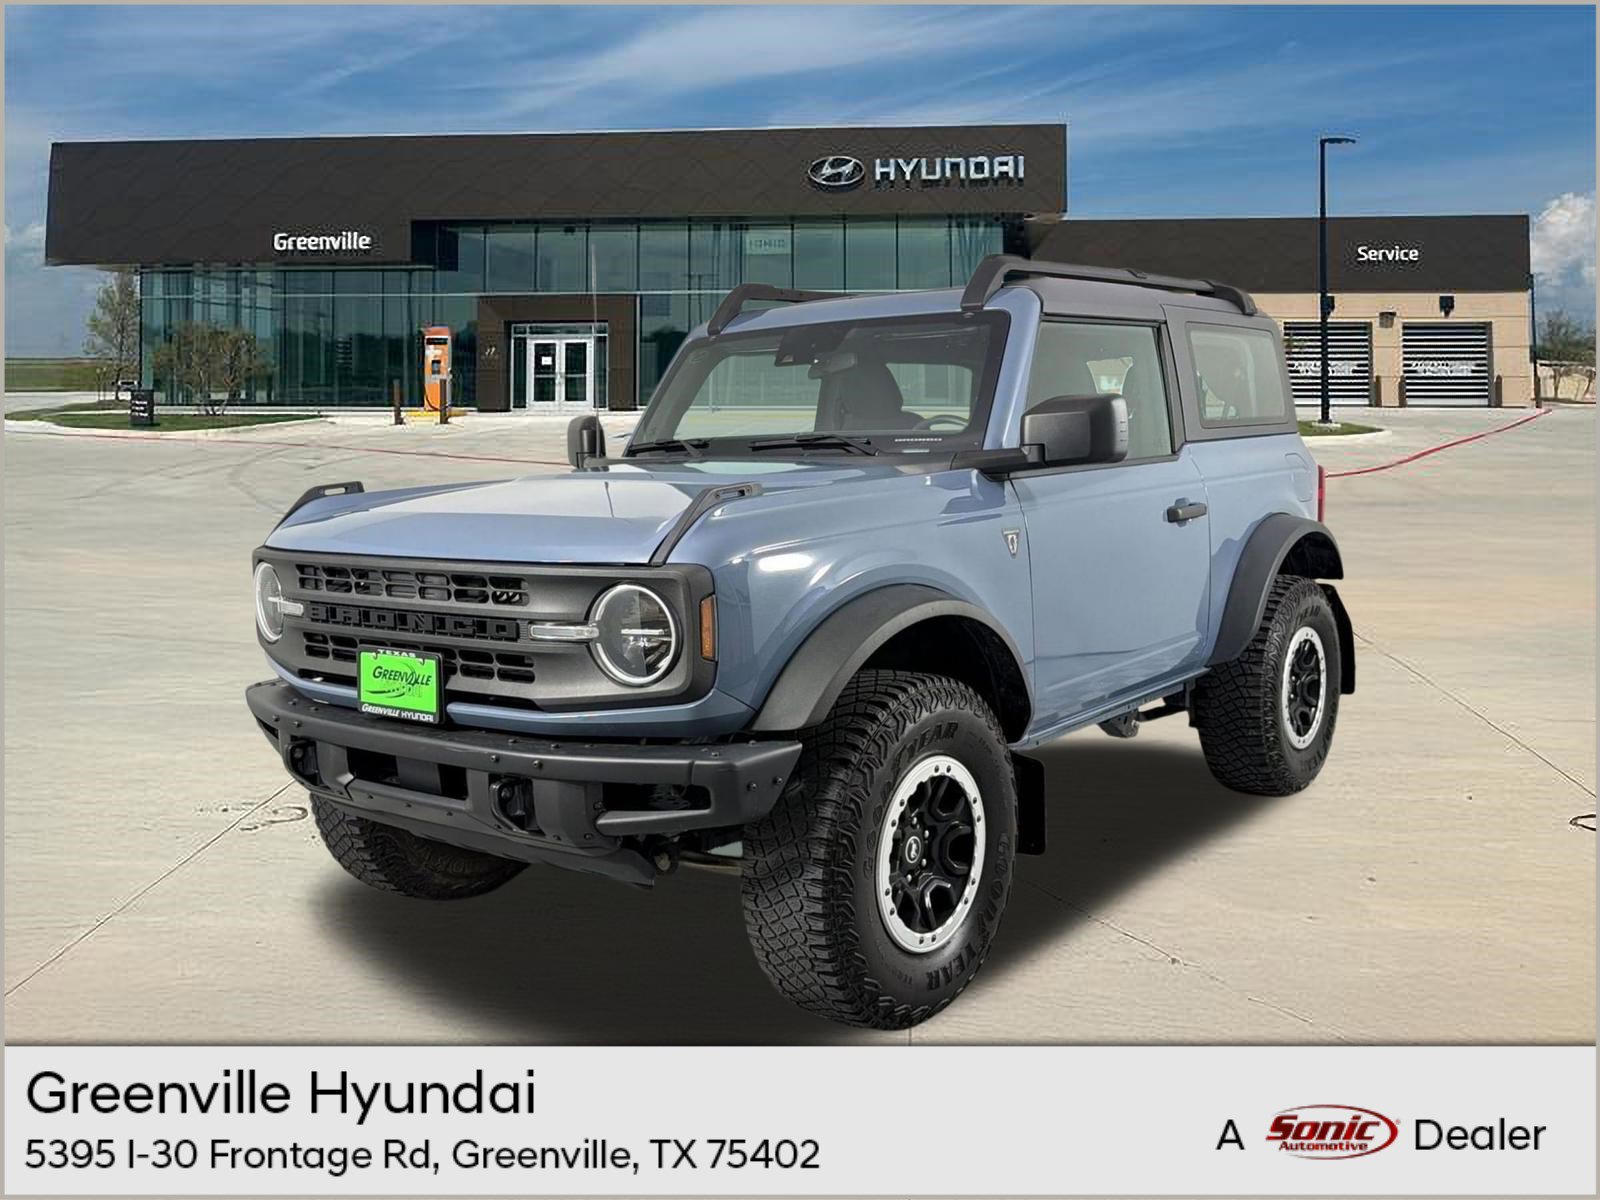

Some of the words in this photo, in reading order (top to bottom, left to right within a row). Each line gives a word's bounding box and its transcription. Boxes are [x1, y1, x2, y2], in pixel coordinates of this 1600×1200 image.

[875, 155, 1025, 181] HYUNDAI
[273, 231, 372, 251] Greenville
[1357, 245, 1419, 261] Service
[308, 602, 520, 641] BRONCO
